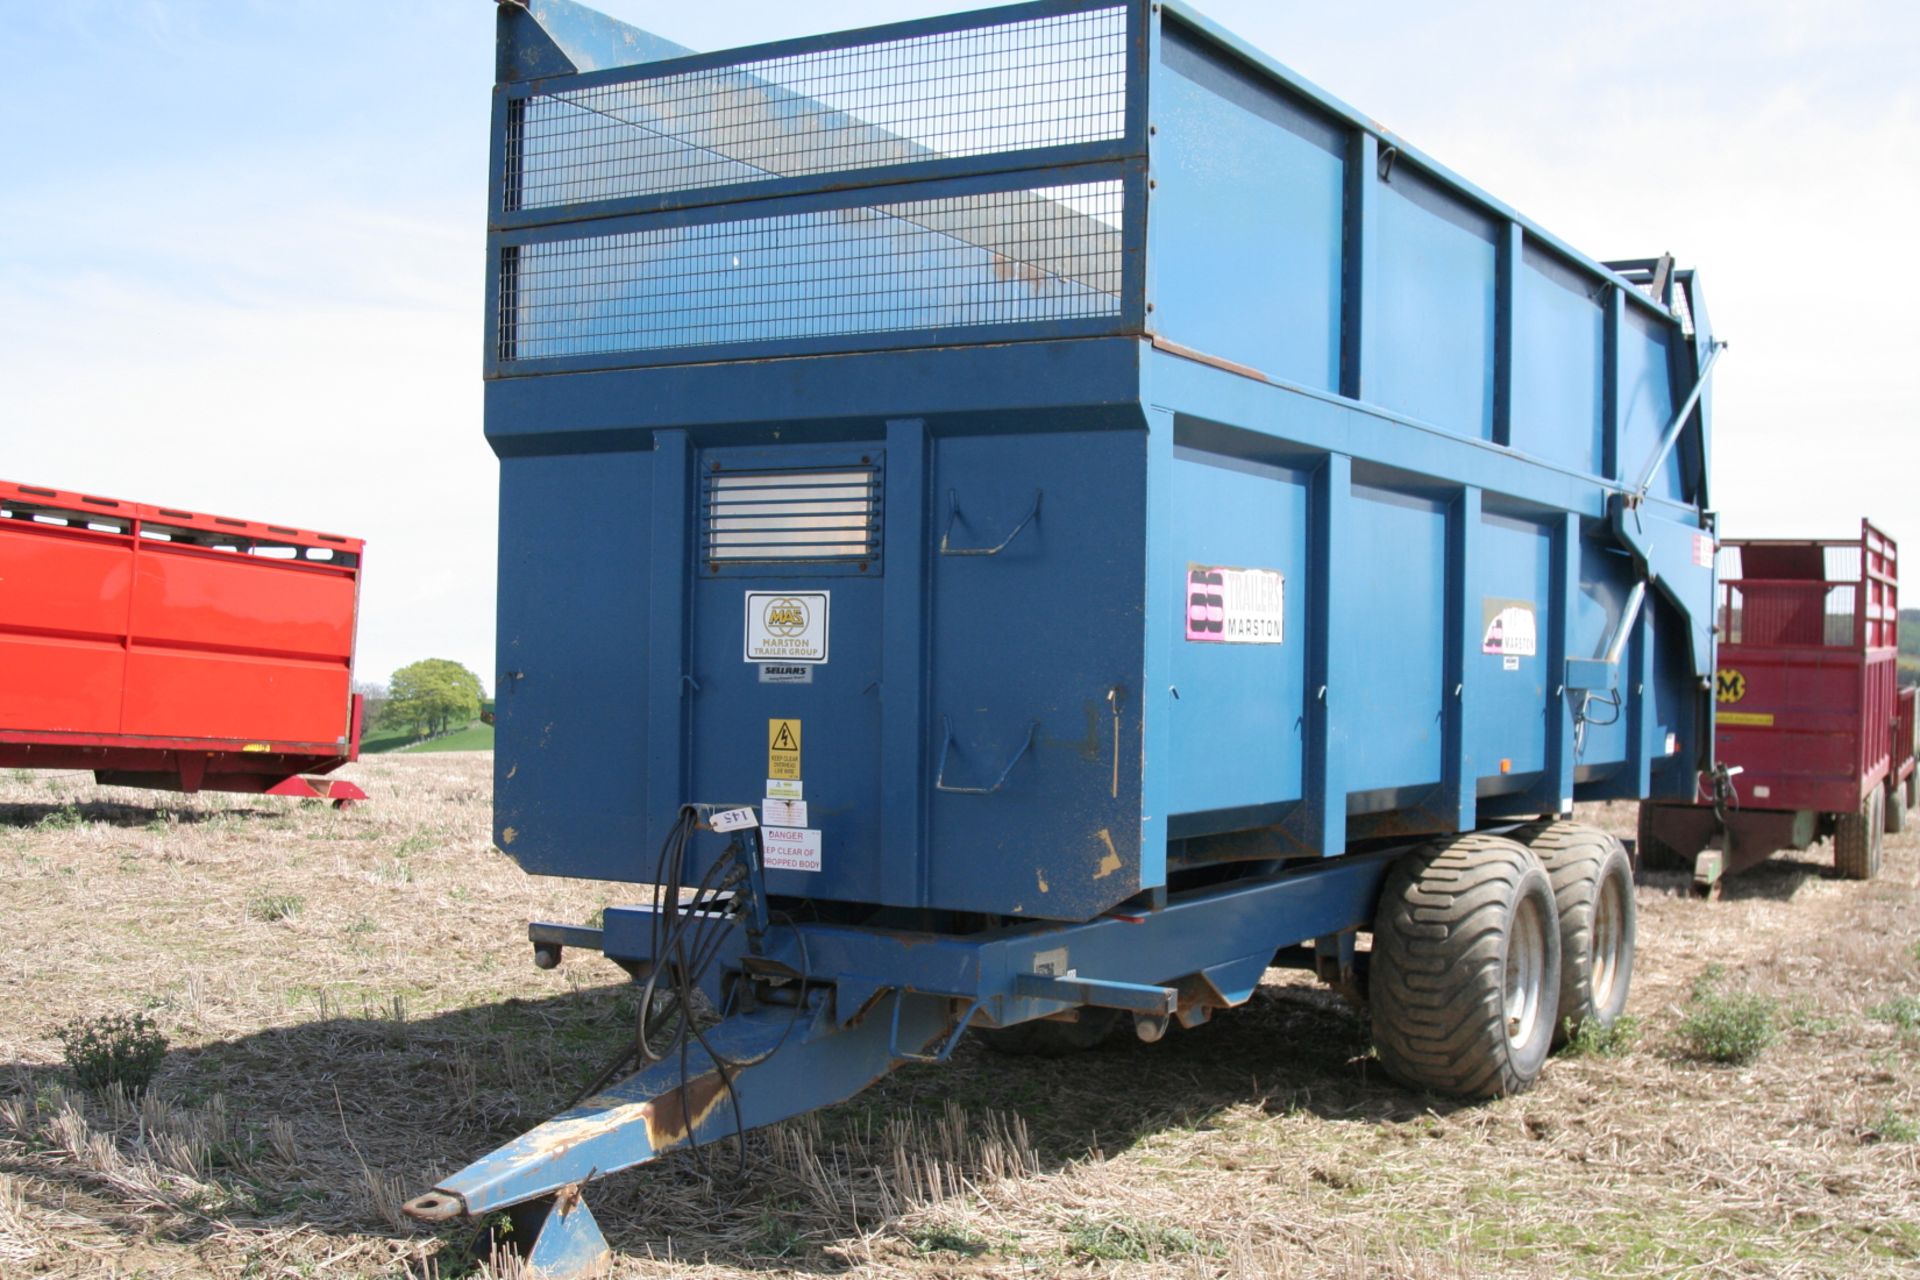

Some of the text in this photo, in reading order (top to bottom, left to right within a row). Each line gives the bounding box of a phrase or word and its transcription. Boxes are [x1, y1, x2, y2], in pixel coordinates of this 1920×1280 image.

[1228, 573, 1280, 612] TRAILERS
[1228, 618, 1280, 637] MARSTON
[763, 639, 809, 647] MARSTON
[789, 648, 818, 656] GROUP
[764, 666, 807, 675] SELLARS
[1717, 676, 1740, 697] M
[723, 810, 748, 824] 145
[768, 831, 804, 839] DANGER
[777, 847, 803, 856] CLEAR
[799, 860, 819, 869] BODY
